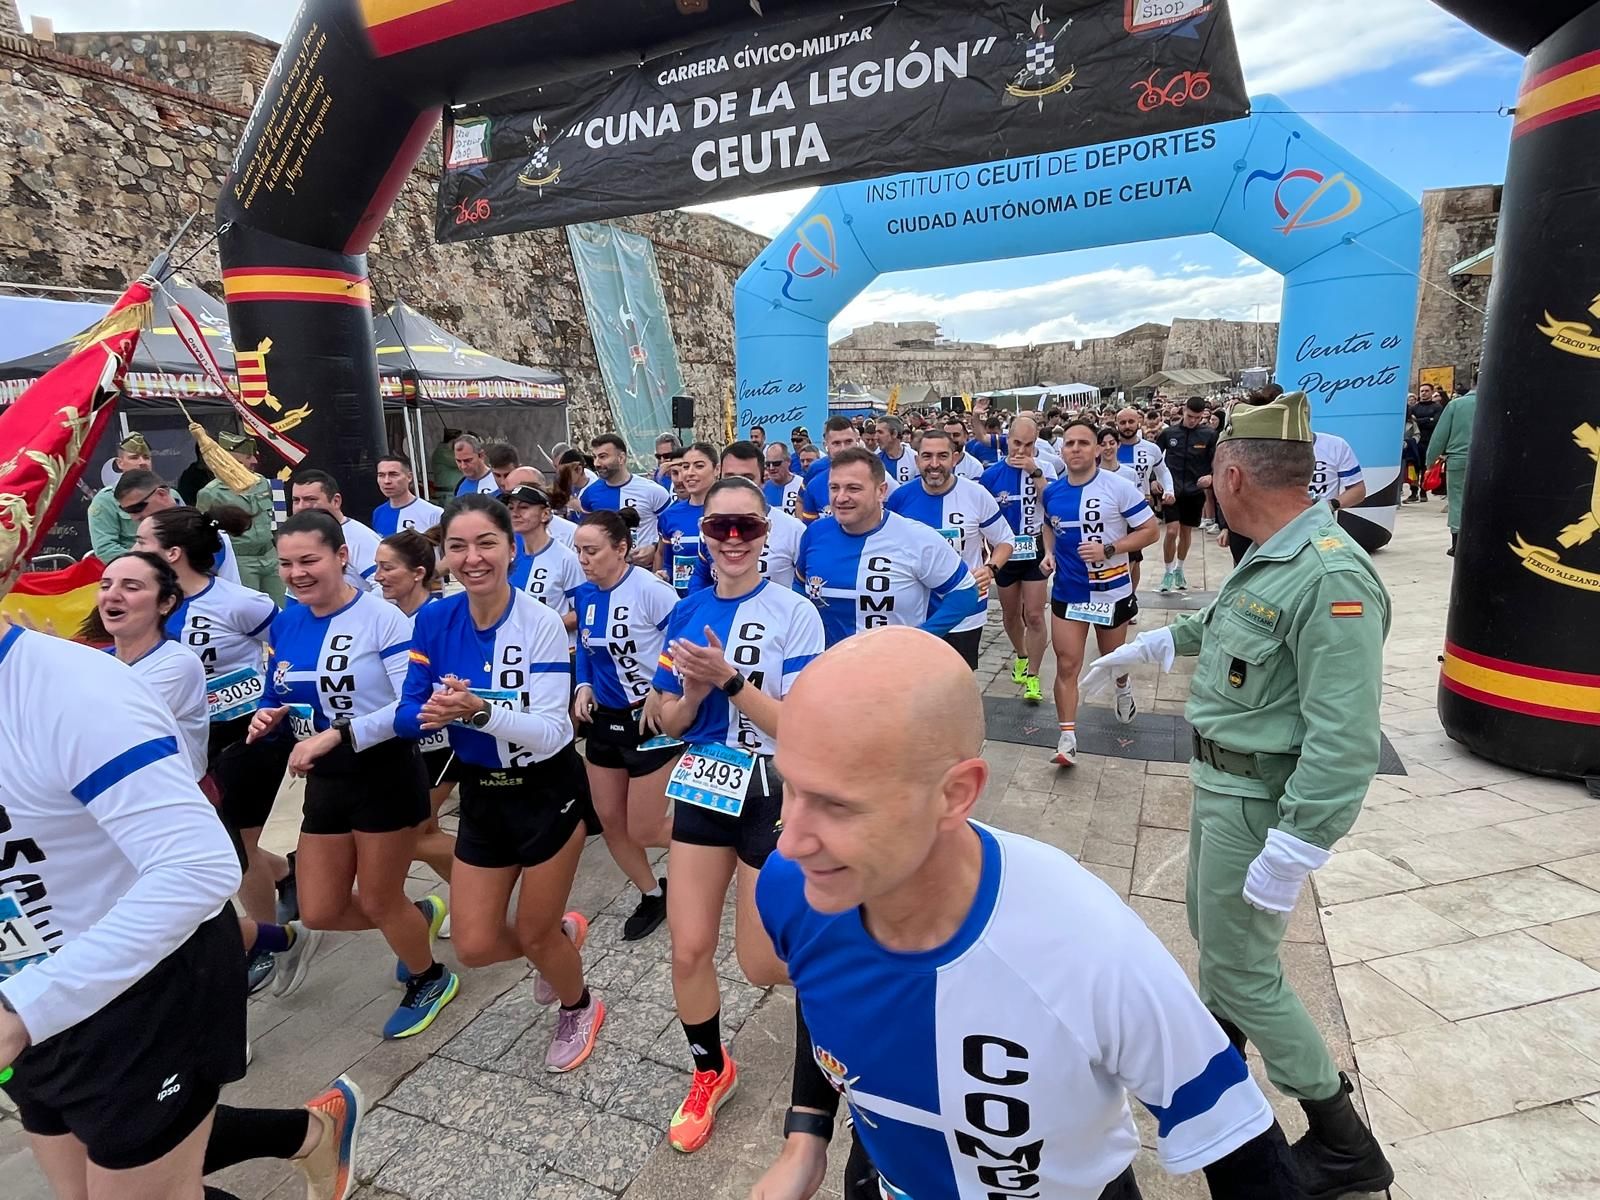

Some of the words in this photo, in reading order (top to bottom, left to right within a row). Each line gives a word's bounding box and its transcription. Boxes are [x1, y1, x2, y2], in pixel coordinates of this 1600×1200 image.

[1142, 1, 1184, 19] Shop
[657, 55, 730, 86] CARRERA
[733, 26, 873, 69] CÍVICO-MILITAR
[566, 103, 681, 149] “CUNA
[693, 91, 738, 129] DE
[749, 80, 795, 117] LA
[809, 36, 998, 106] LEGIÓN”
[270, 138, 295, 182] distancia
[303, 75, 325, 113] enemigo
[286, 154, 305, 182] llegar
[307, 94, 333, 138] bayoneta
[692, 122, 831, 182] CEUTA
[867, 171, 970, 203] INSTITUTO
[977, 155, 1041, 187] CEUTÍ
[1048, 153, 1078, 176] DE
[1085, 128, 1216, 170] DEPORTES
[887, 212, 957, 235] CIUDAD
[962, 194, 1078, 226] AUTÓNOMA
[1084, 188, 1113, 208] DE
[1119, 176, 1193, 202] CEUTA
[1296, 332, 1375, 362] Ceuta
[1380, 334, 1402, 349] es
[1555, 334, 1586, 350] TERCIO
[419, 379, 468, 398] TERCIO
[739, 379, 783, 401] Ceuta
[787, 382, 807, 393] es
[1297, 365, 1400, 404] Deporte
[741, 406, 808, 427] Deporte
[1527, 556, 1555, 574] TERCIO
[1556, 569, 1600, 588] "ALEJAND
[609, 606, 651, 696] COMGEC
[220, 677, 262, 704] 3039
[694, 758, 744, 789] 3493
[954, 1034, 1045, 1200] COMG
